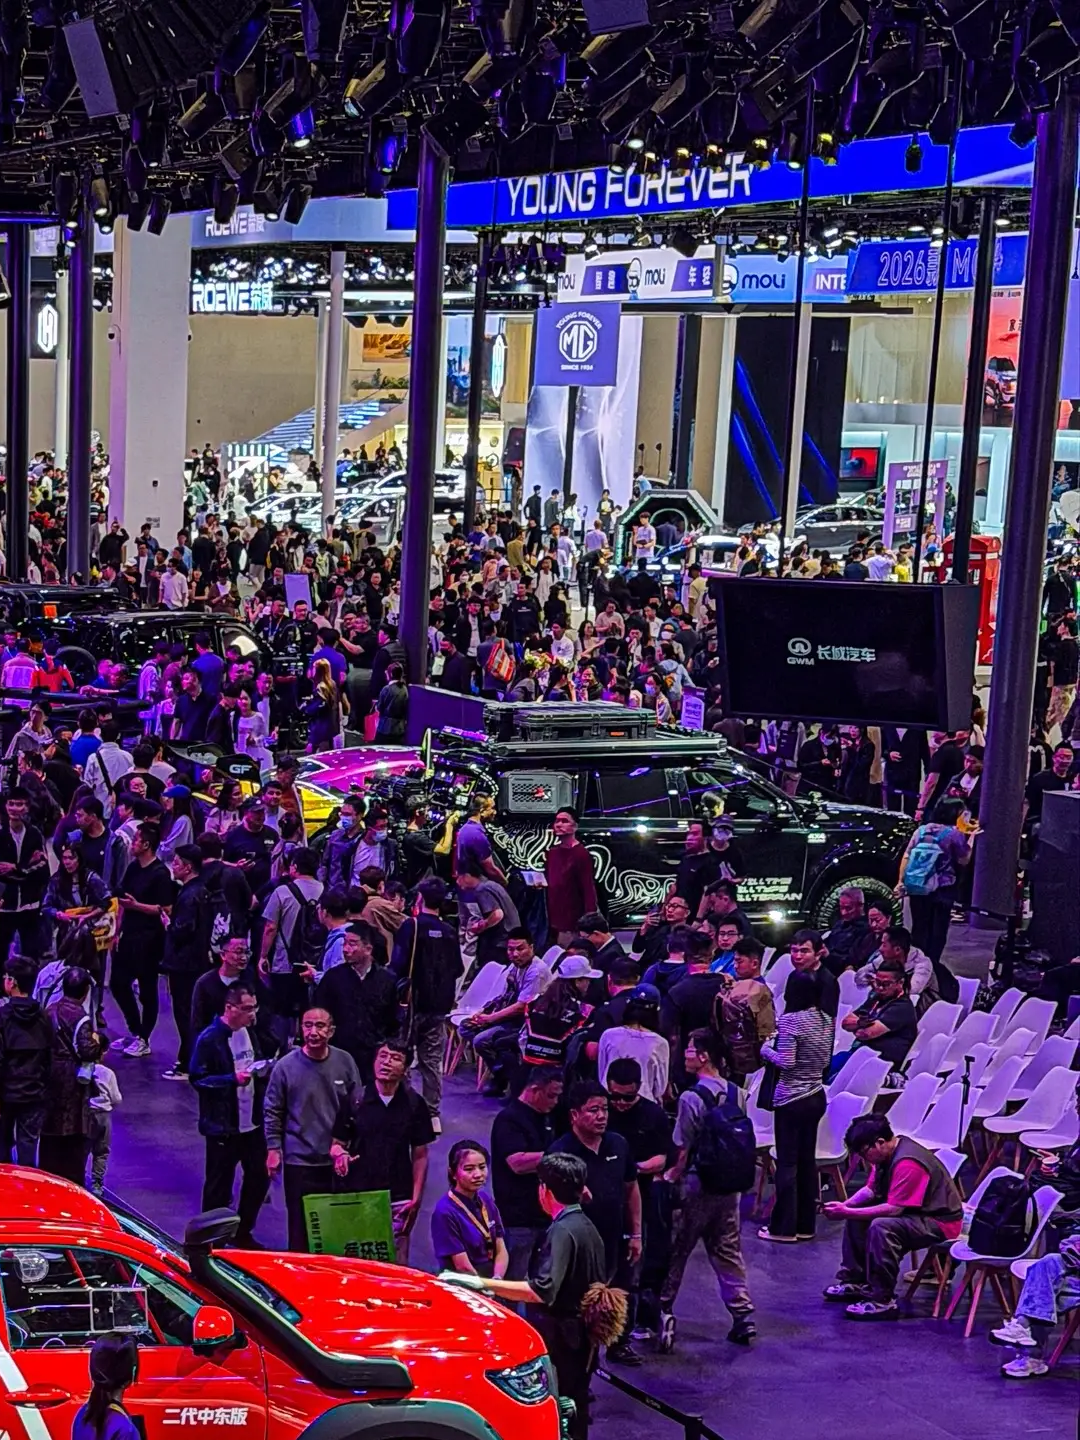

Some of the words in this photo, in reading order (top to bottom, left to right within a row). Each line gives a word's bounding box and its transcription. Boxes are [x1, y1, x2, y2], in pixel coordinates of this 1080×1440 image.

[507, 172, 597, 217] YOUNG
[605, 151, 754, 209] FOREVER
[205, 213, 248, 237] ROEWE
[192, 282, 250, 312] ROEWE
[555, 312, 578, 329] YOUNG
[578, 311, 603, 330] FOREVER
[563, 324, 594, 359] MG
[786, 656, 815, 666] GWM
[817, 645, 876, 662] 长城汽车
[229, 763, 253, 775] GF
[162, 1407, 249, 1425] 二代中东版
